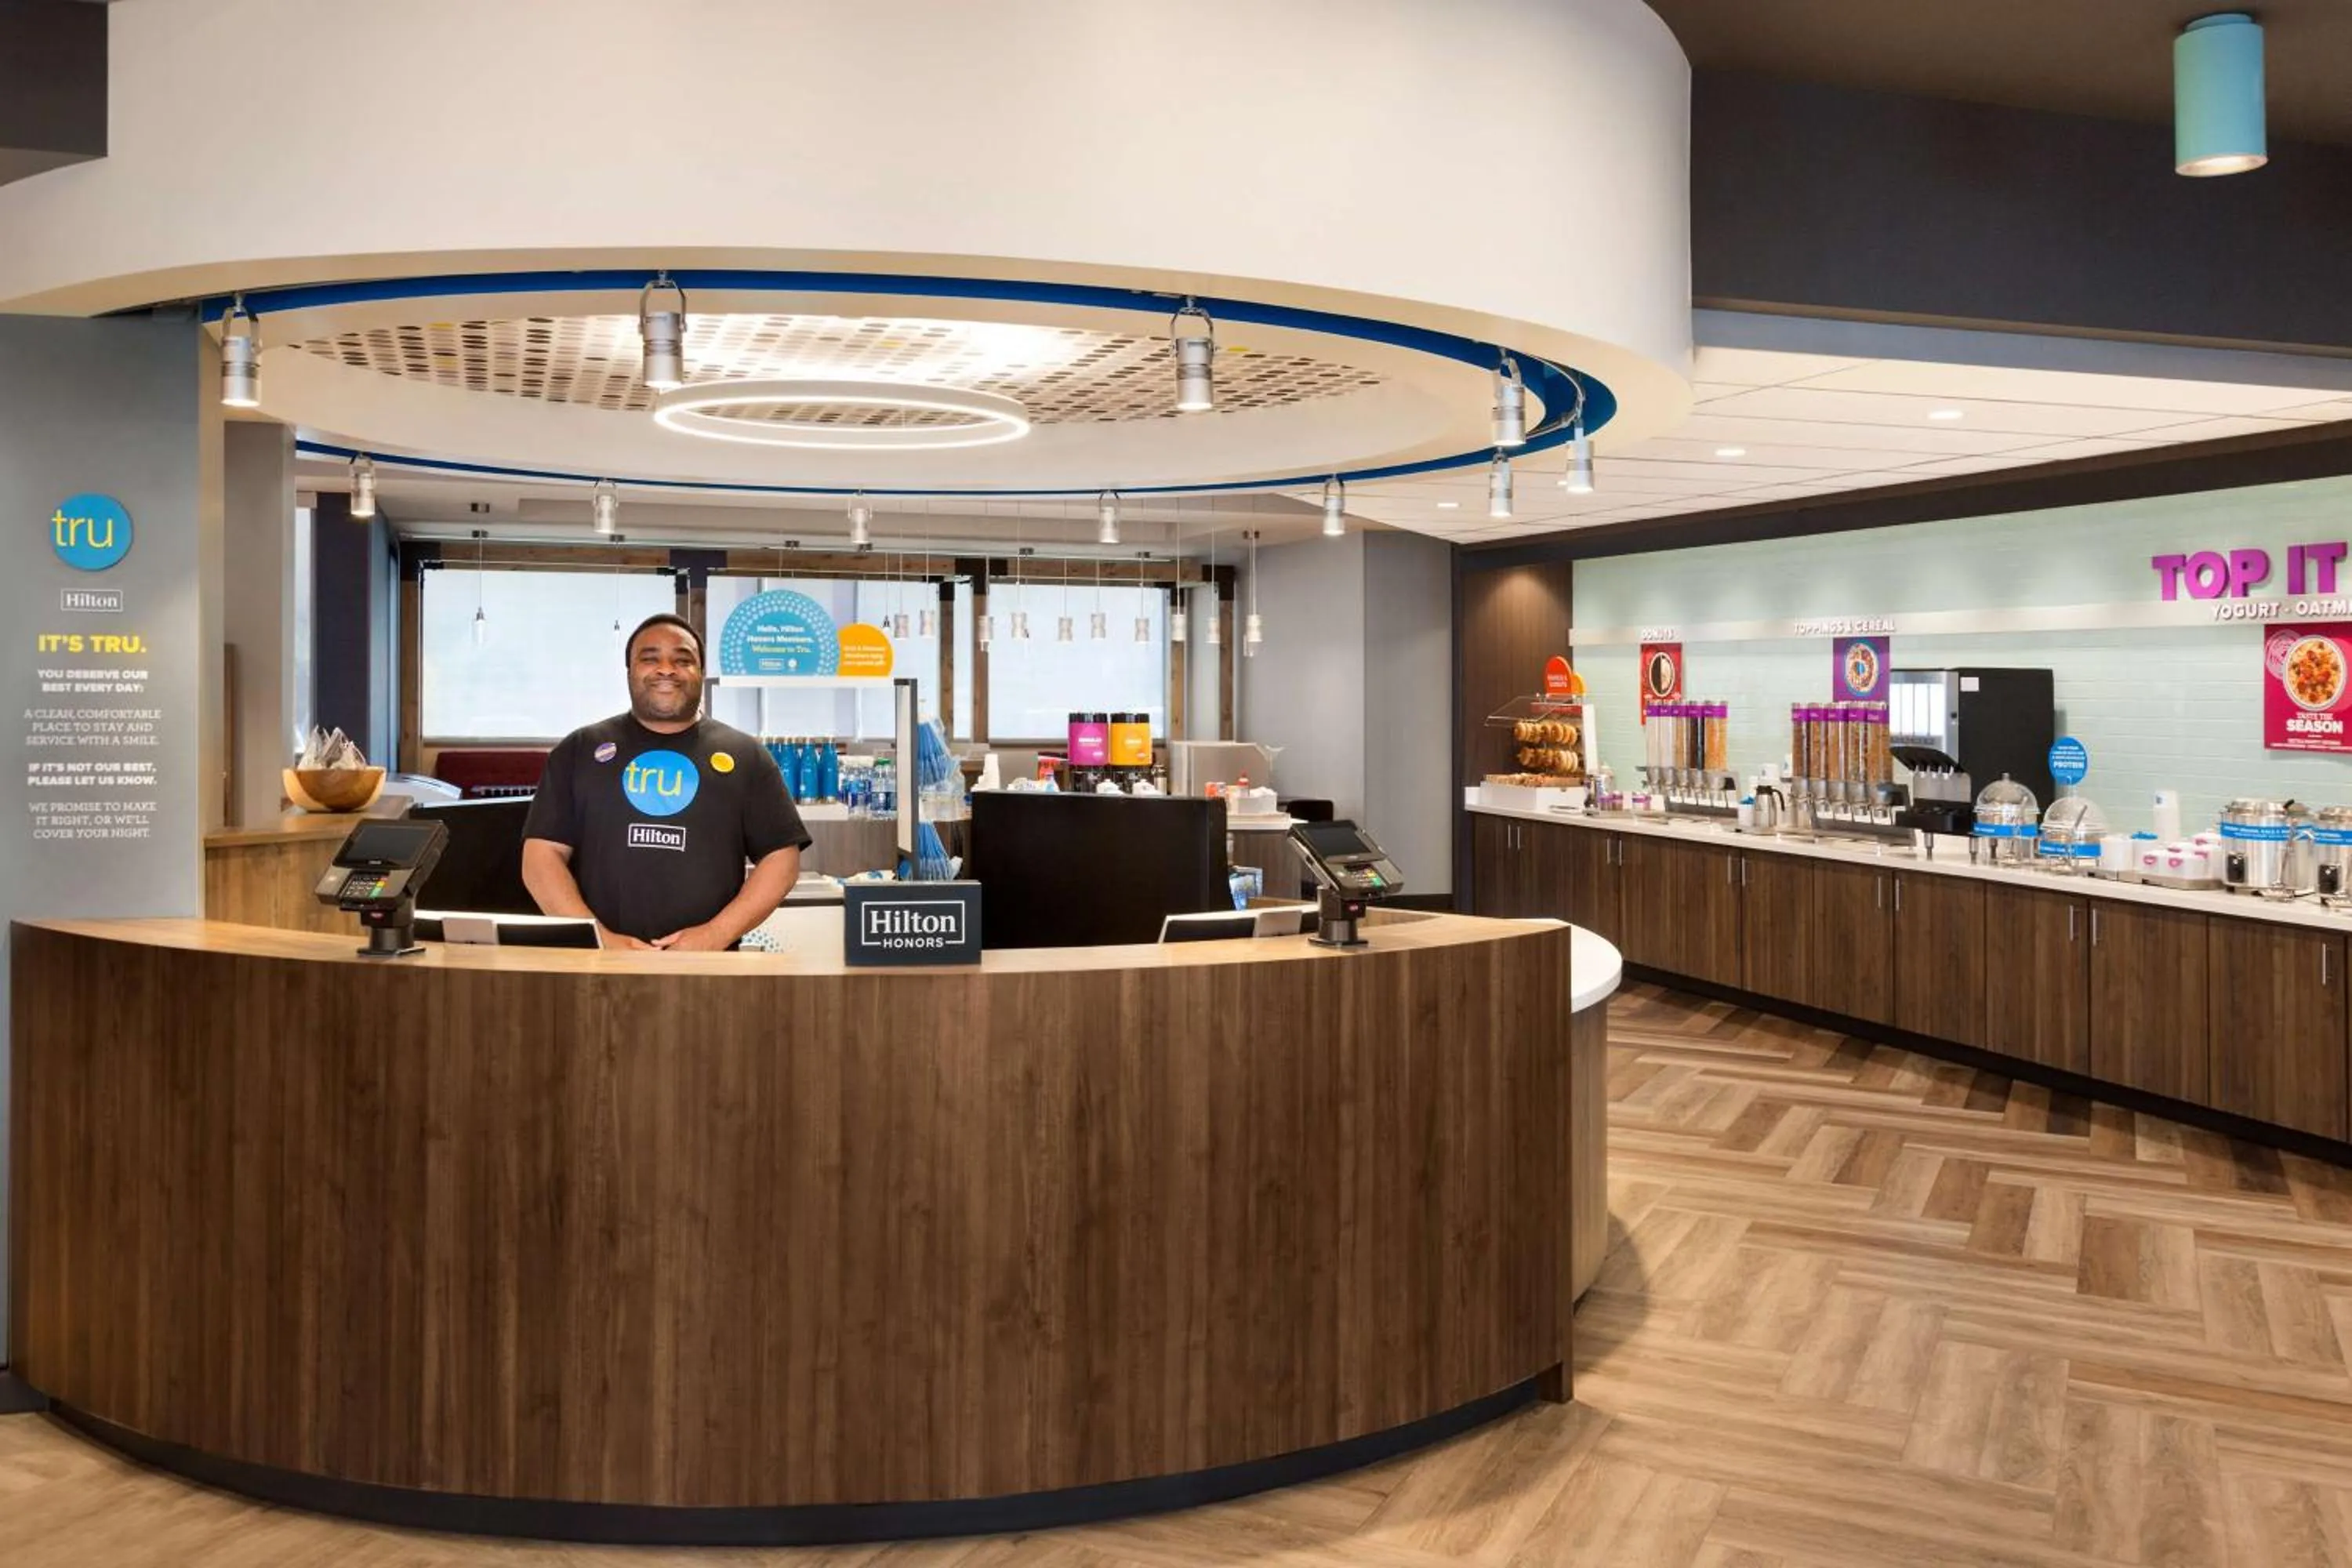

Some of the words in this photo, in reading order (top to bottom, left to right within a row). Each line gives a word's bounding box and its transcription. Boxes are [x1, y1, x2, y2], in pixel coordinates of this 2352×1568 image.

[51, 509, 113, 548] tru
[2152, 549, 2270, 601] TOP
[2287, 541, 2348, 595] IT
[66, 593, 118, 608] Hilton
[2212, 601, 2280, 620] YOGURT
[2296, 600, 2352, 617] OATM
[1794, 621, 1845, 635] TOPPINGS
[1855, 619, 1896, 633] CEREAL
[38, 633, 84, 652] IT'S
[89, 634, 147, 653] TRU.
[38, 669, 64, 679] YOU
[66, 670, 119, 679] DESERVE
[122, 670, 148, 680] OUR
[42, 683, 71, 692] BEST
[74, 683, 112, 692] EVERY
[24, 709, 33, 719] A
[77, 709, 162, 719] COMFORTABLE
[32, 722, 71, 732] PLACE
[73, 722, 90, 731] TO
[93, 722, 124, 732] STAY
[126, 722, 153, 731] AND
[2285, 719, 2343, 734] SEASON
[26, 735, 74, 745] SERVICE
[77, 735, 111, 745] WITH
[112, 735, 121, 745] A
[28, 763, 40, 772] IF
[42, 763, 64, 772] IT'S
[67, 763, 92, 772] NOT
[94, 763, 121, 772] OUR
[27, 775, 72, 786] PLEASE
[74, 775, 96, 785] LET
[98, 775, 114, 785] US
[118, 775, 157, 785] KNOW.
[625, 761, 683, 797] tru
[28, 802, 49, 812] WE
[50, 802, 101, 811] PROMISE
[103, 802, 121, 811] TO
[123, 802, 157, 811] MAKE
[36, 815, 48, 826] IT
[94, 815, 111, 824] OR
[114, 815, 150, 824] WE'LL
[33, 828, 74, 838] COVER
[76, 828, 110, 838] YOUR
[633, 827, 681, 845] Hilton
[869, 909, 956, 934] Hilton
[883, 937, 945, 949] HONORS
